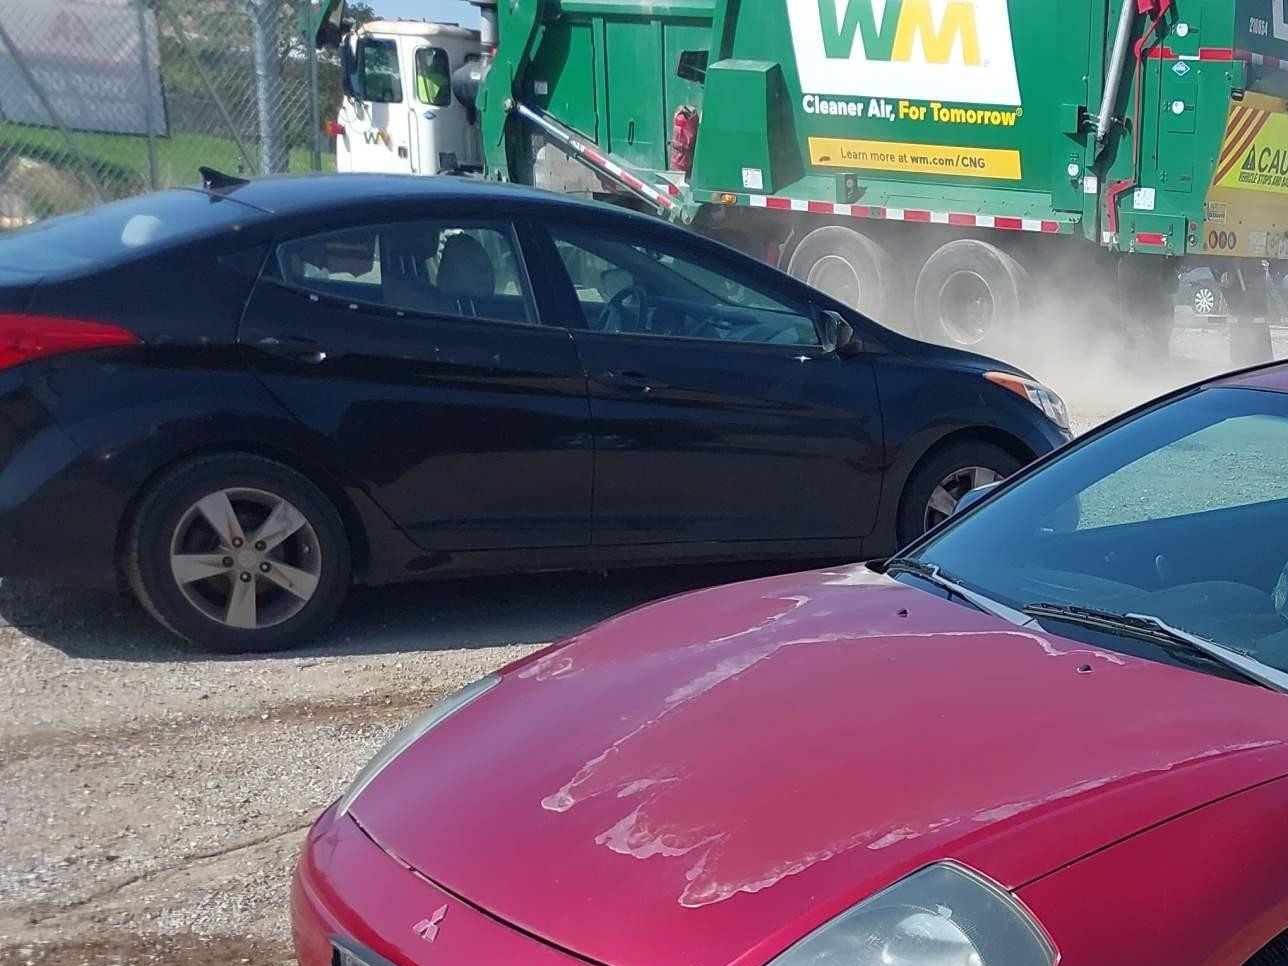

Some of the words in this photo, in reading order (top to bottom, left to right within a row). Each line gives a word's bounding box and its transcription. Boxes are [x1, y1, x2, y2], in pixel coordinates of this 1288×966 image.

[818, 0, 983, 66] WM
[802, 94, 864, 117] Cleaner
[867, 98, 896, 122] Air,
[898, 100, 927, 121] For
[840, 147, 869, 160] Learn
[870, 152, 897, 163] more
[898, 153, 908, 164] at
[910, 154, 986, 169] wm.com/CNG
[1257, 173, 1272, 186] STOPS
